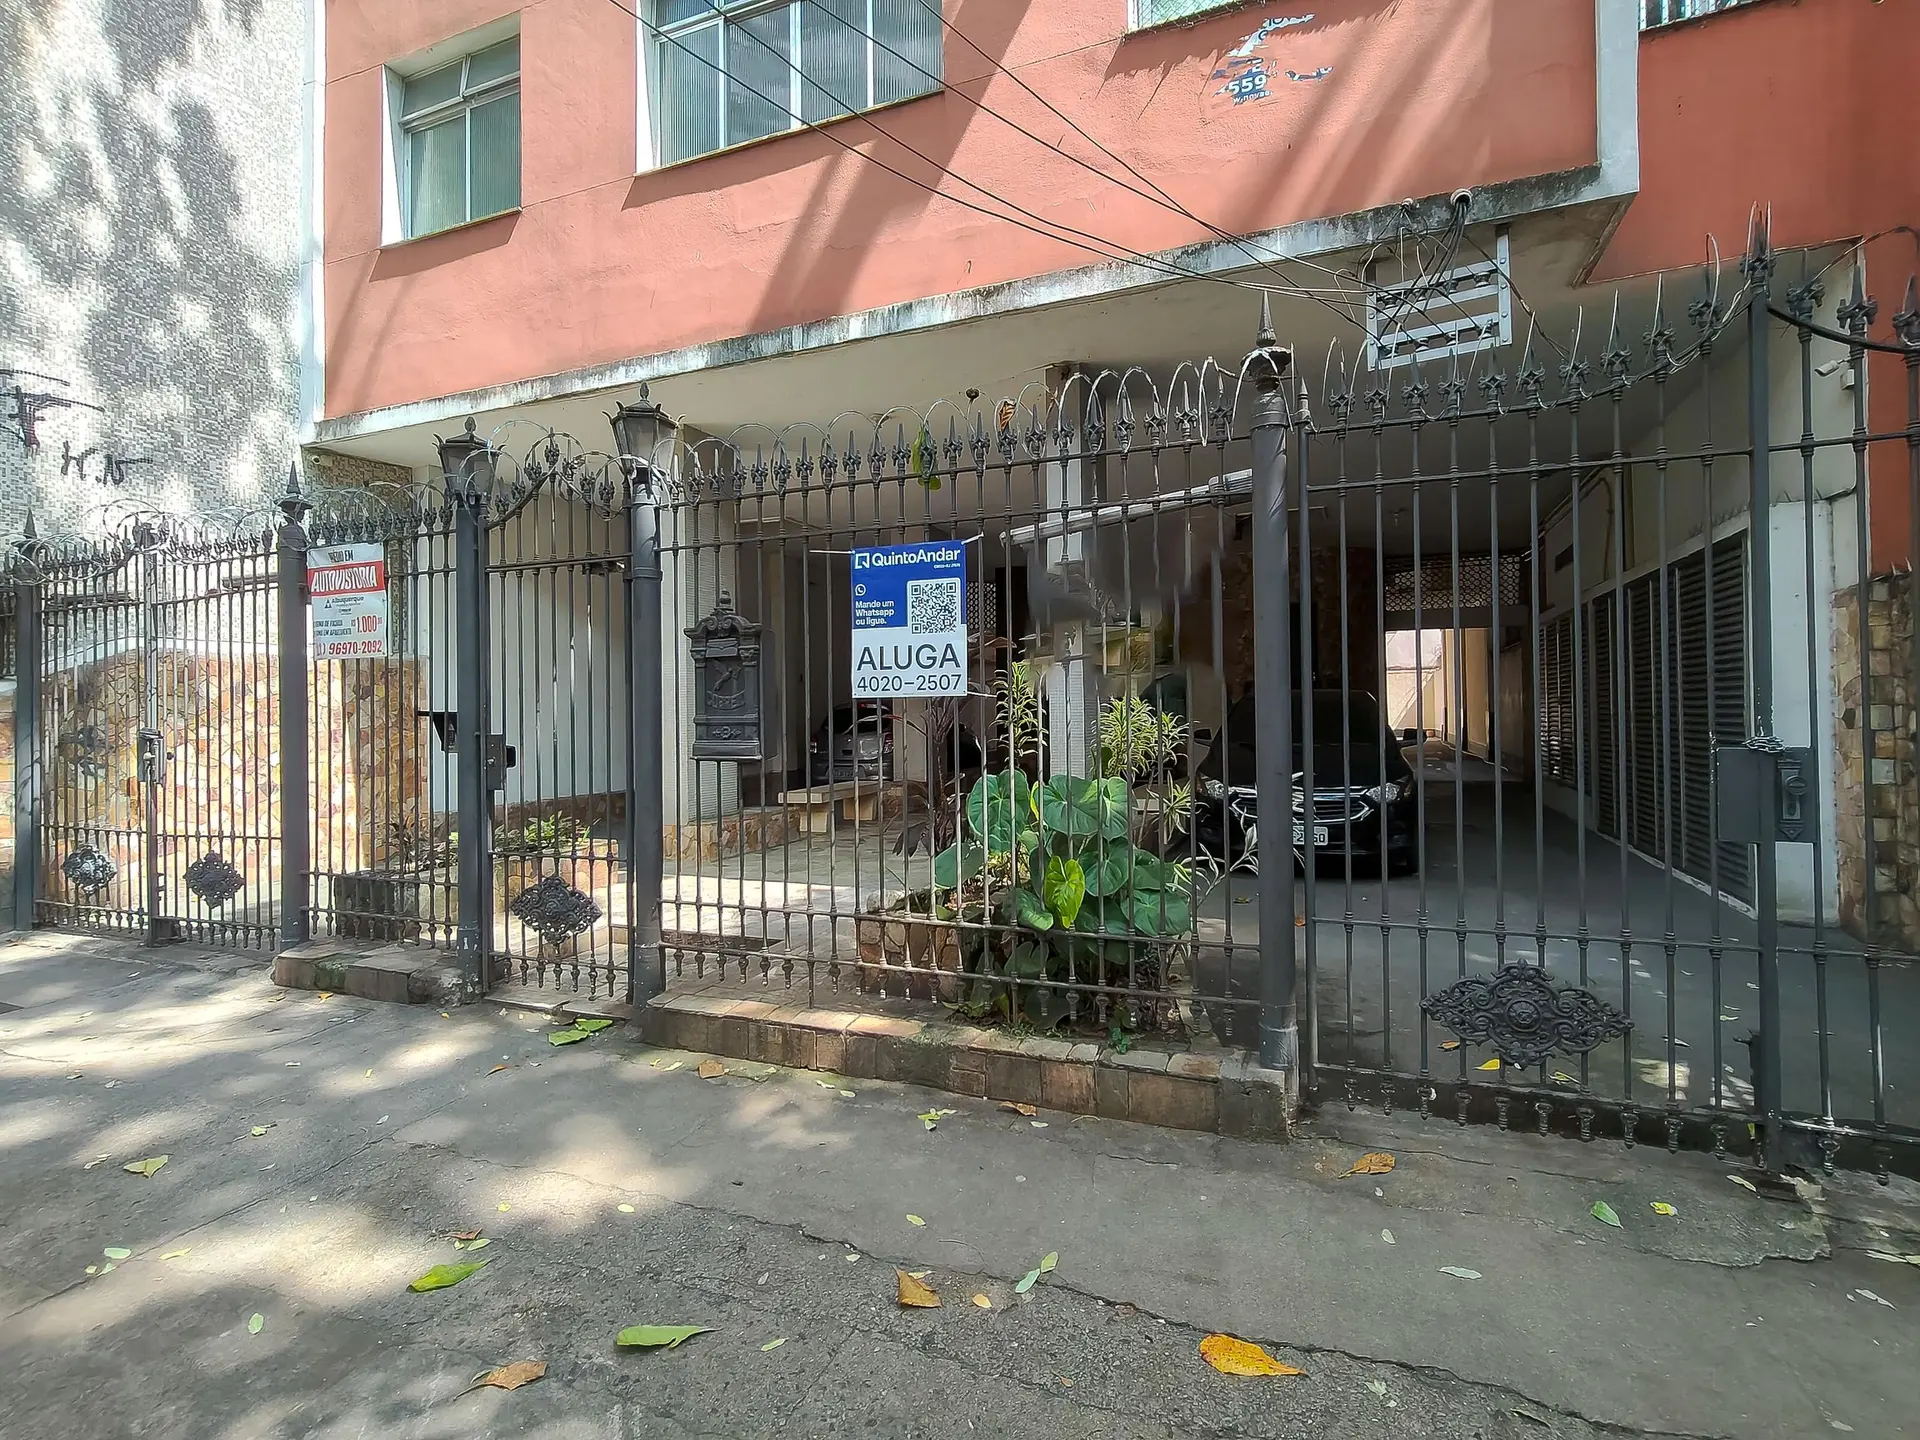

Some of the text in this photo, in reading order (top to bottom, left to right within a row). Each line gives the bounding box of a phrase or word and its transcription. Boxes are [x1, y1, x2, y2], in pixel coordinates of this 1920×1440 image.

[1228, 74, 1267, 95] 559
[345, 549, 354, 561] EM
[872, 547, 961, 567] QuintoAndar
[311, 565, 378, 592] AUTOVISTORIA
[331, 596, 364, 604] Albuquerque
[855, 600, 881, 609] Mande
[855, 608, 895, 618] Whatsapp
[855, 617, 888, 627] ou ligue.
[328, 640, 383, 655] 96970-2092
[856, 643, 962, 671] ALUGA
[857, 673, 962, 693] 4020-2507
